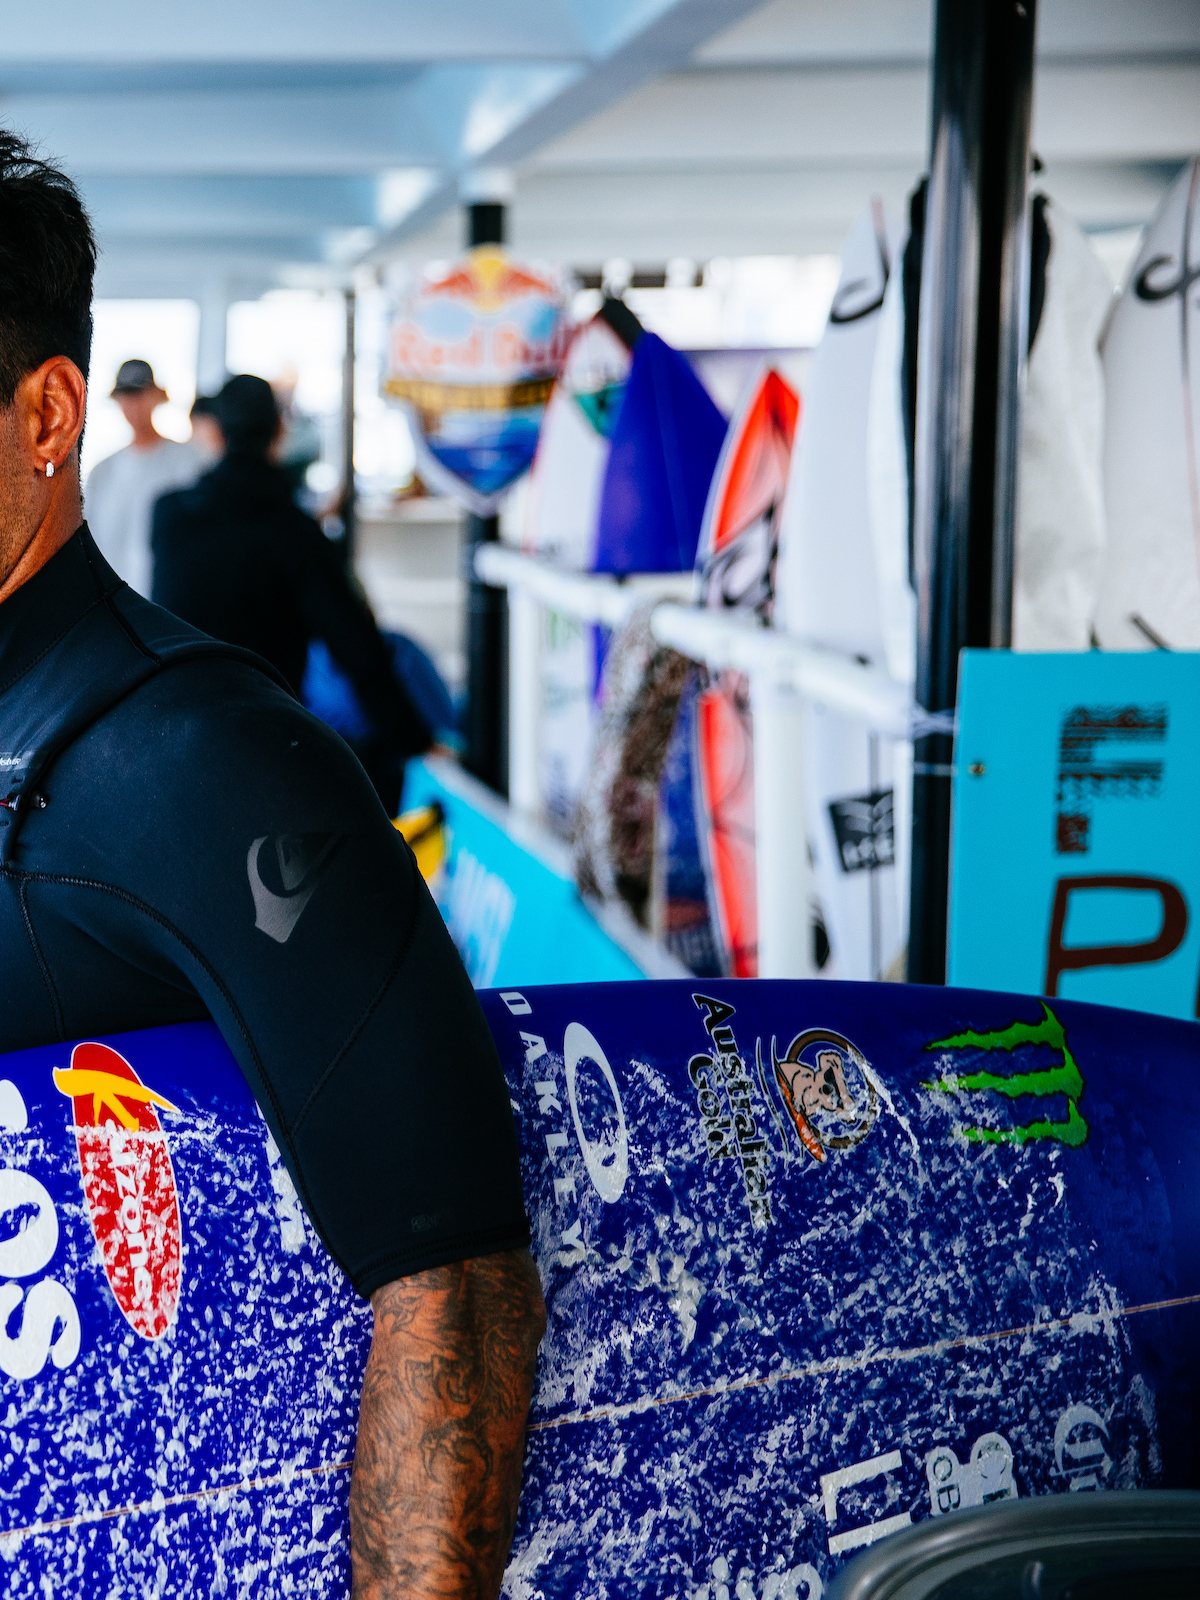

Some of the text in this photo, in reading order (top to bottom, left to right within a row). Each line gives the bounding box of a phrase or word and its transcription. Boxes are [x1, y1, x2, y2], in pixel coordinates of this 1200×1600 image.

[499, 992, 587, 1263] OAKLEY
[687, 1053, 738, 1160] Gold
[691, 993, 776, 1230] Australian
